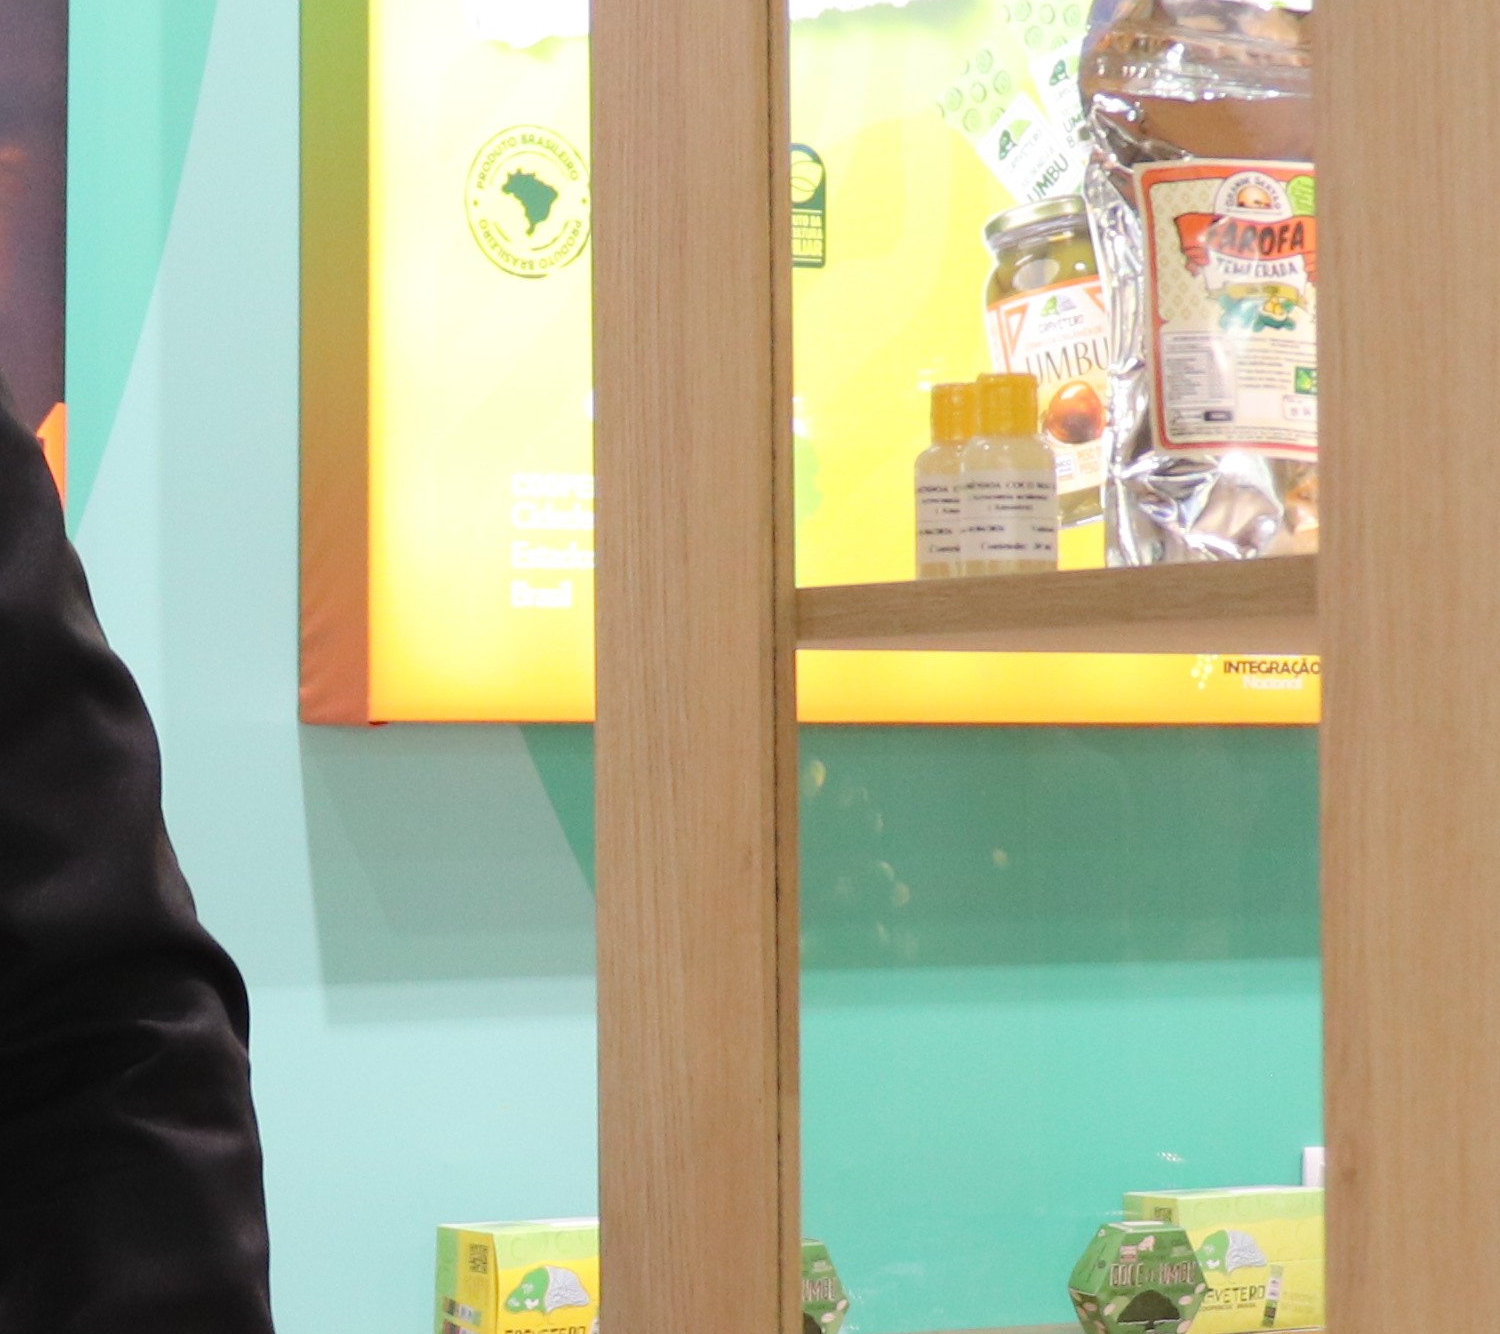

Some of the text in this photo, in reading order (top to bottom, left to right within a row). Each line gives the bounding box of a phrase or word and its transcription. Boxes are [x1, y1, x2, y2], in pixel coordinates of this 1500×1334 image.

[520, 133, 579, 182] BRASILEIRO
[1025, 336, 1110, 385] UMBU
[1223, 657, 1321, 678] INTEGRAÇÃO
